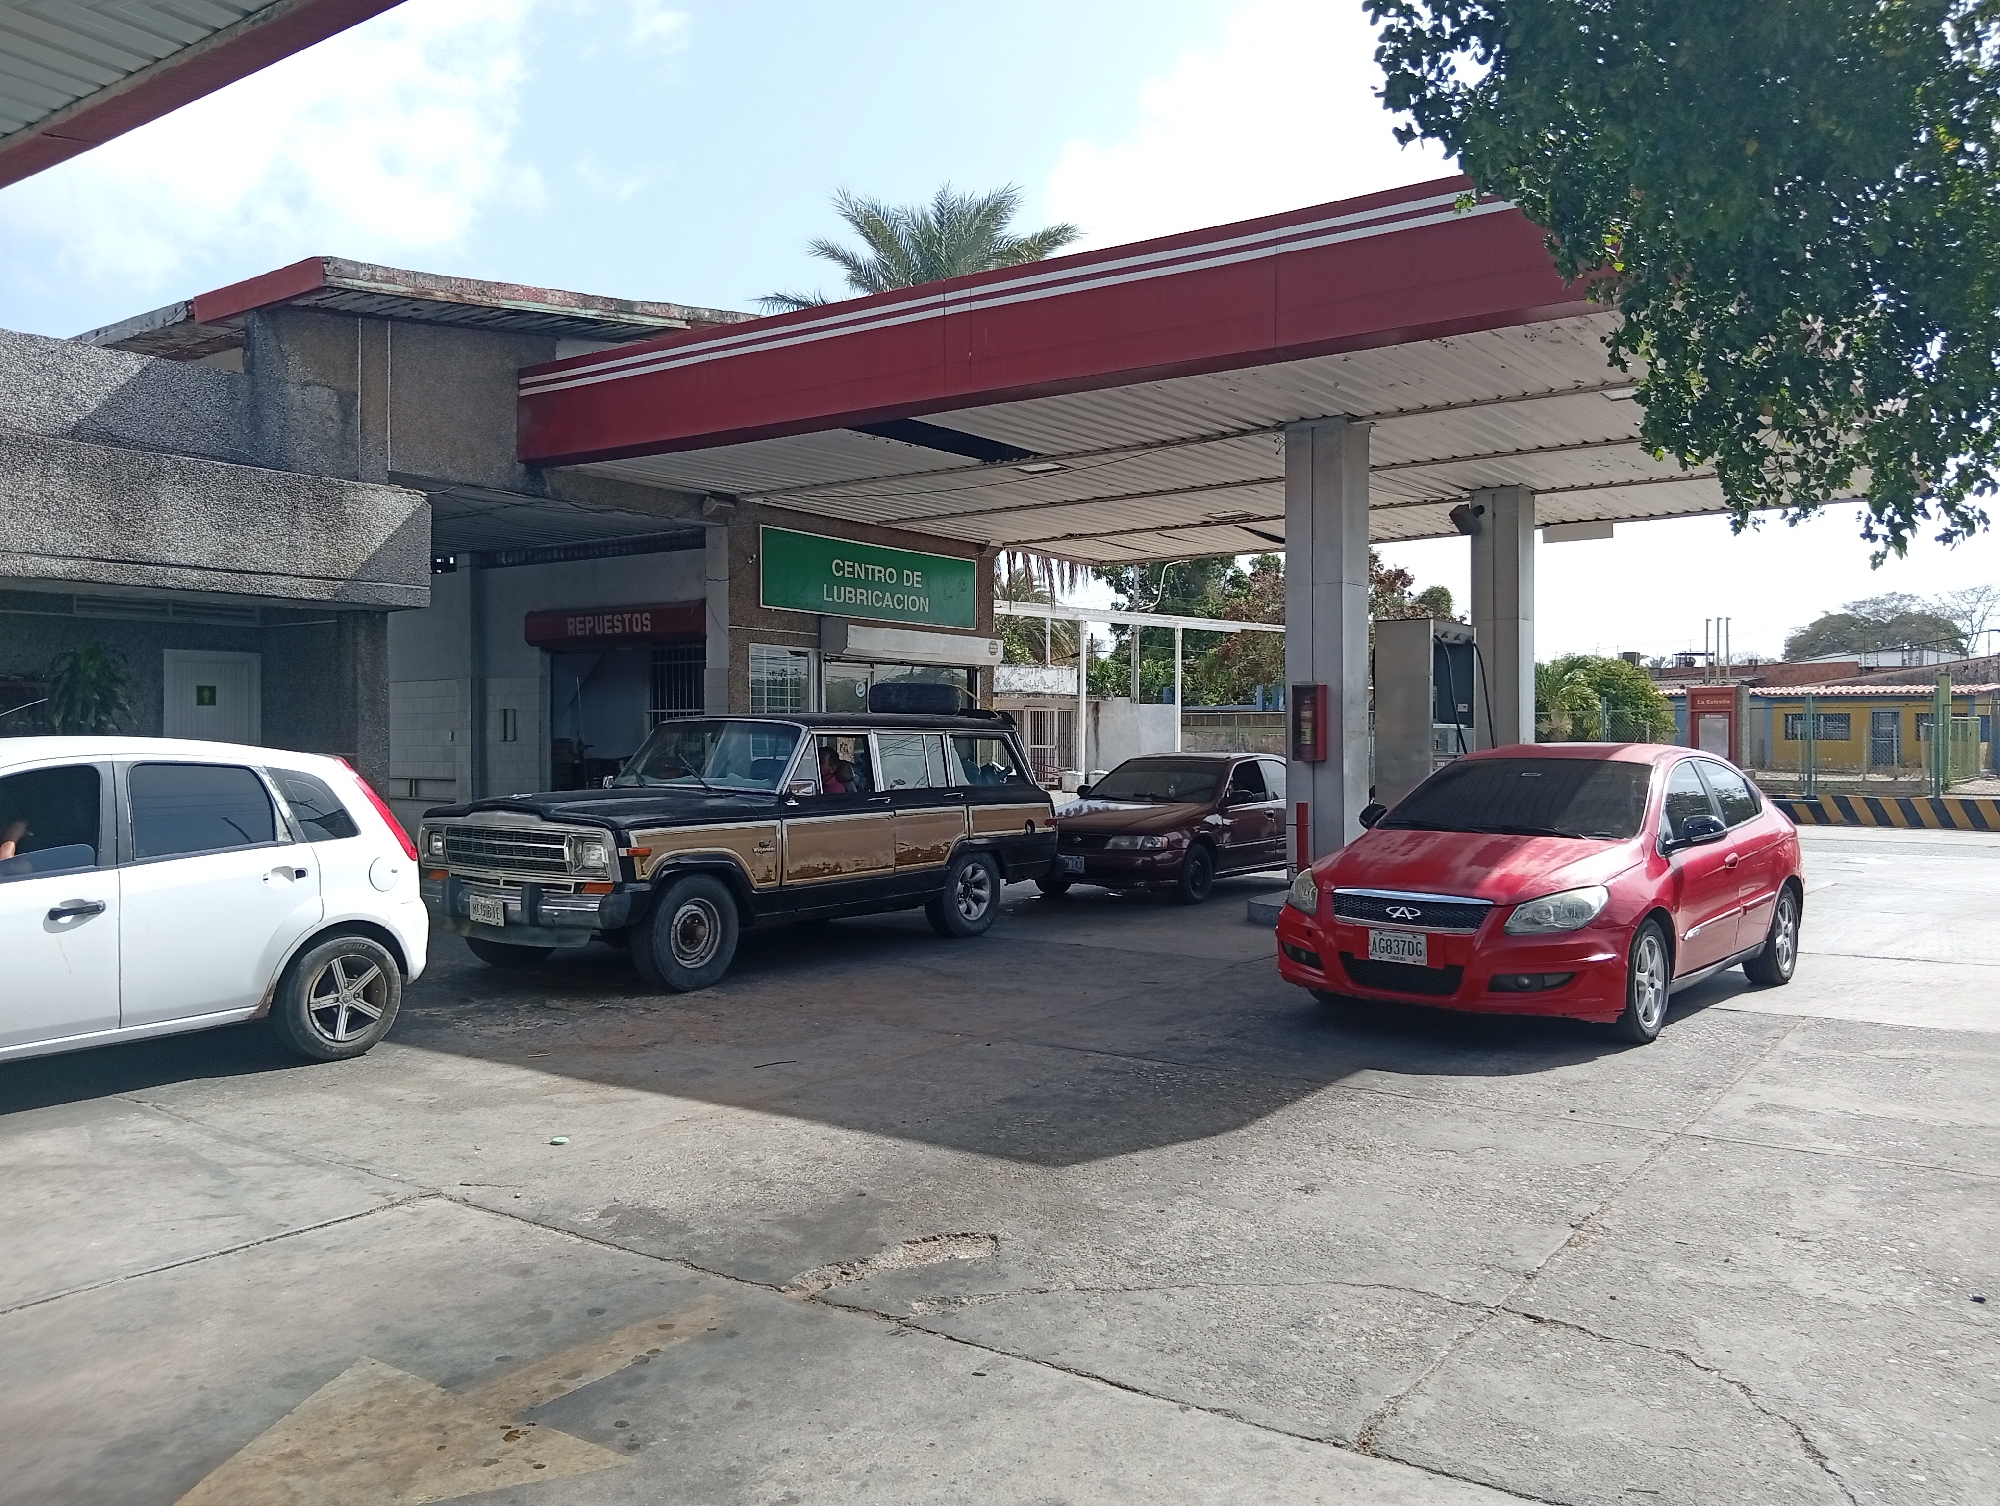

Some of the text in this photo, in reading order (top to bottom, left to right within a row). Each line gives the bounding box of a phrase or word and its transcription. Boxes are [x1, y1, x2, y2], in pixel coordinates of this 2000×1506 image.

[831, 558, 923, 588] CENTRO DE
[823, 583, 930, 613] LUBRICACION
[567, 612, 651, 636] REPUESTOS
[1371, 936, 1423, 957] AG837DG
